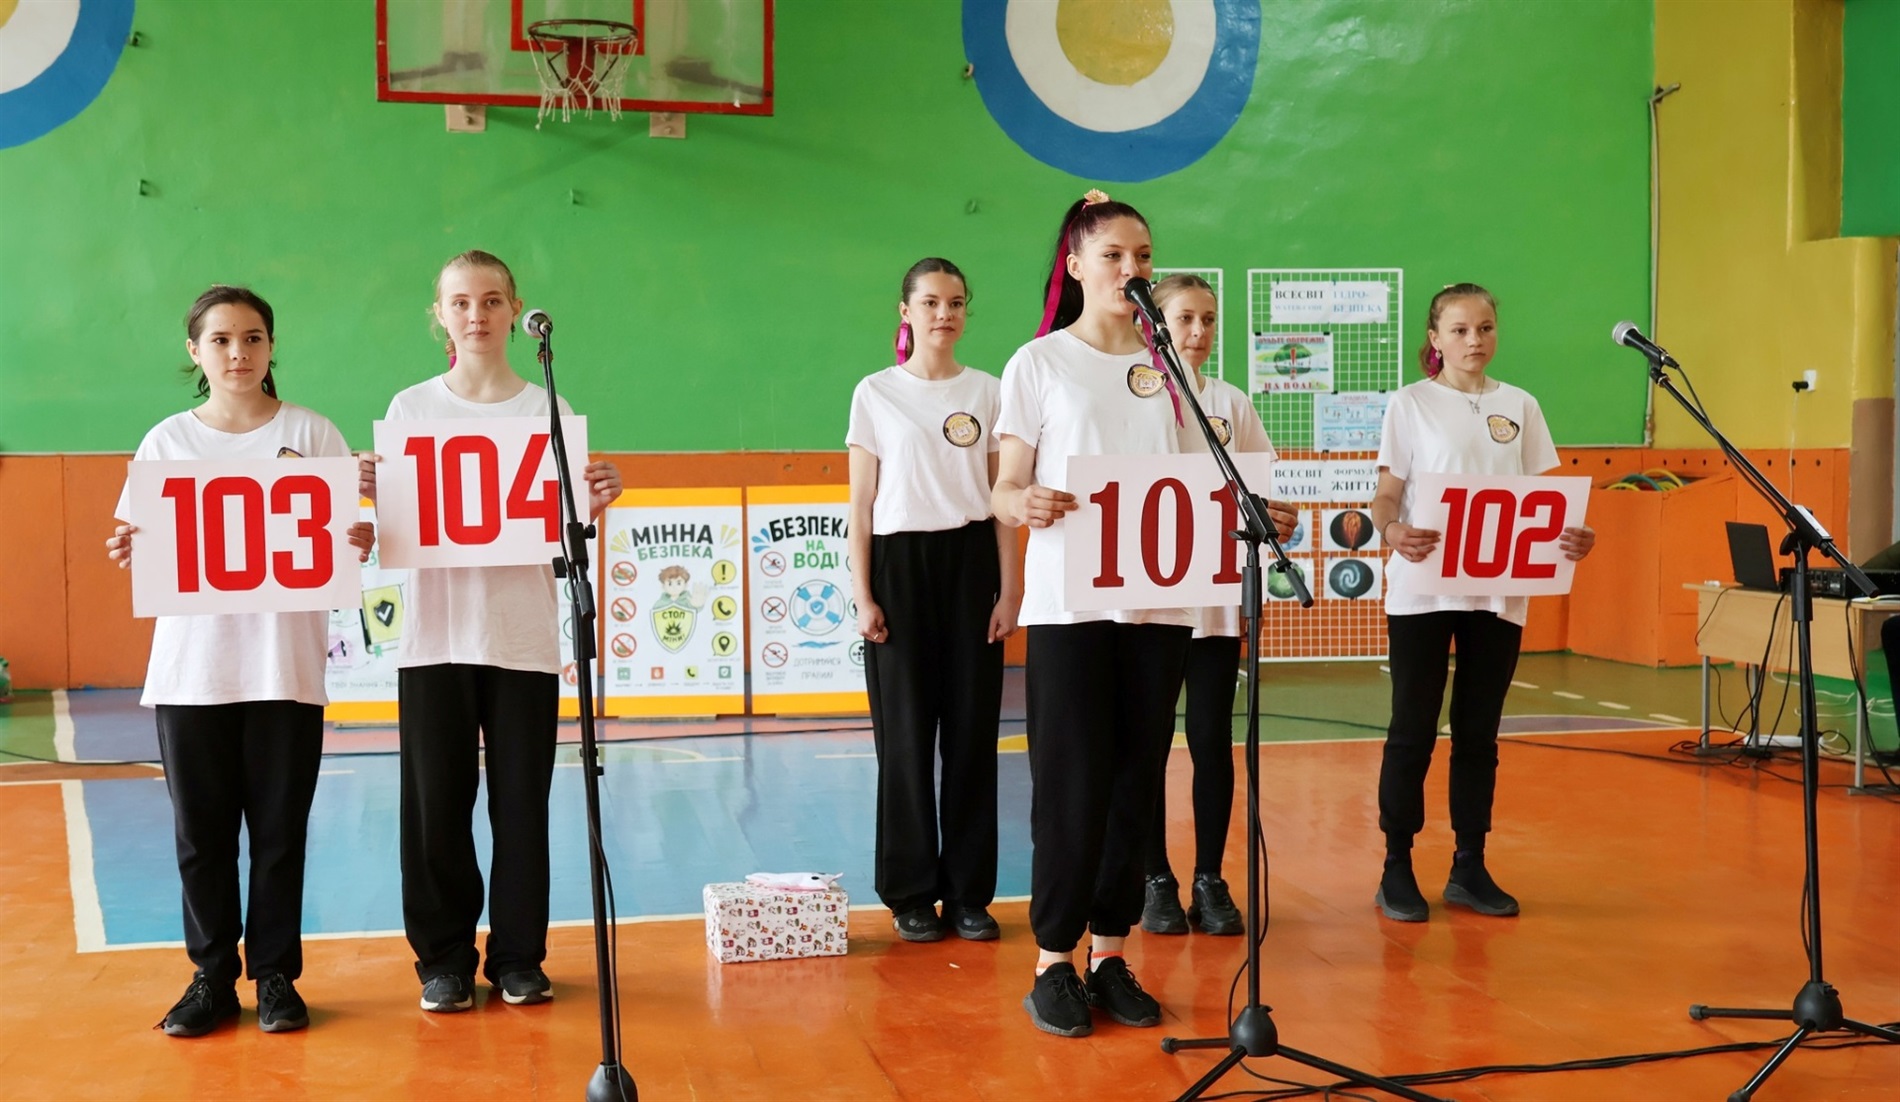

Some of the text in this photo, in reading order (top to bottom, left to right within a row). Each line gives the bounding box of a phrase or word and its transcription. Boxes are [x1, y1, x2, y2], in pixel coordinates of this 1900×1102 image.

[1275, 290, 1324, 299] ВСЕСВІТ
[1275, 469, 1322, 478] ВСЕСВІТ
[404, 433, 560, 547] 104
[161, 475, 334, 593] 103
[631, 523, 713, 547] МІННА
[1089, 477, 1242, 588] 101
[1440, 487, 1567, 579] 102
[637, 544, 713, 561] БЕЗПЕКА
[806, 539, 826, 551] НА
[793, 551, 839, 570] ВОДІ
[662, 610, 686, 620] СТОП
